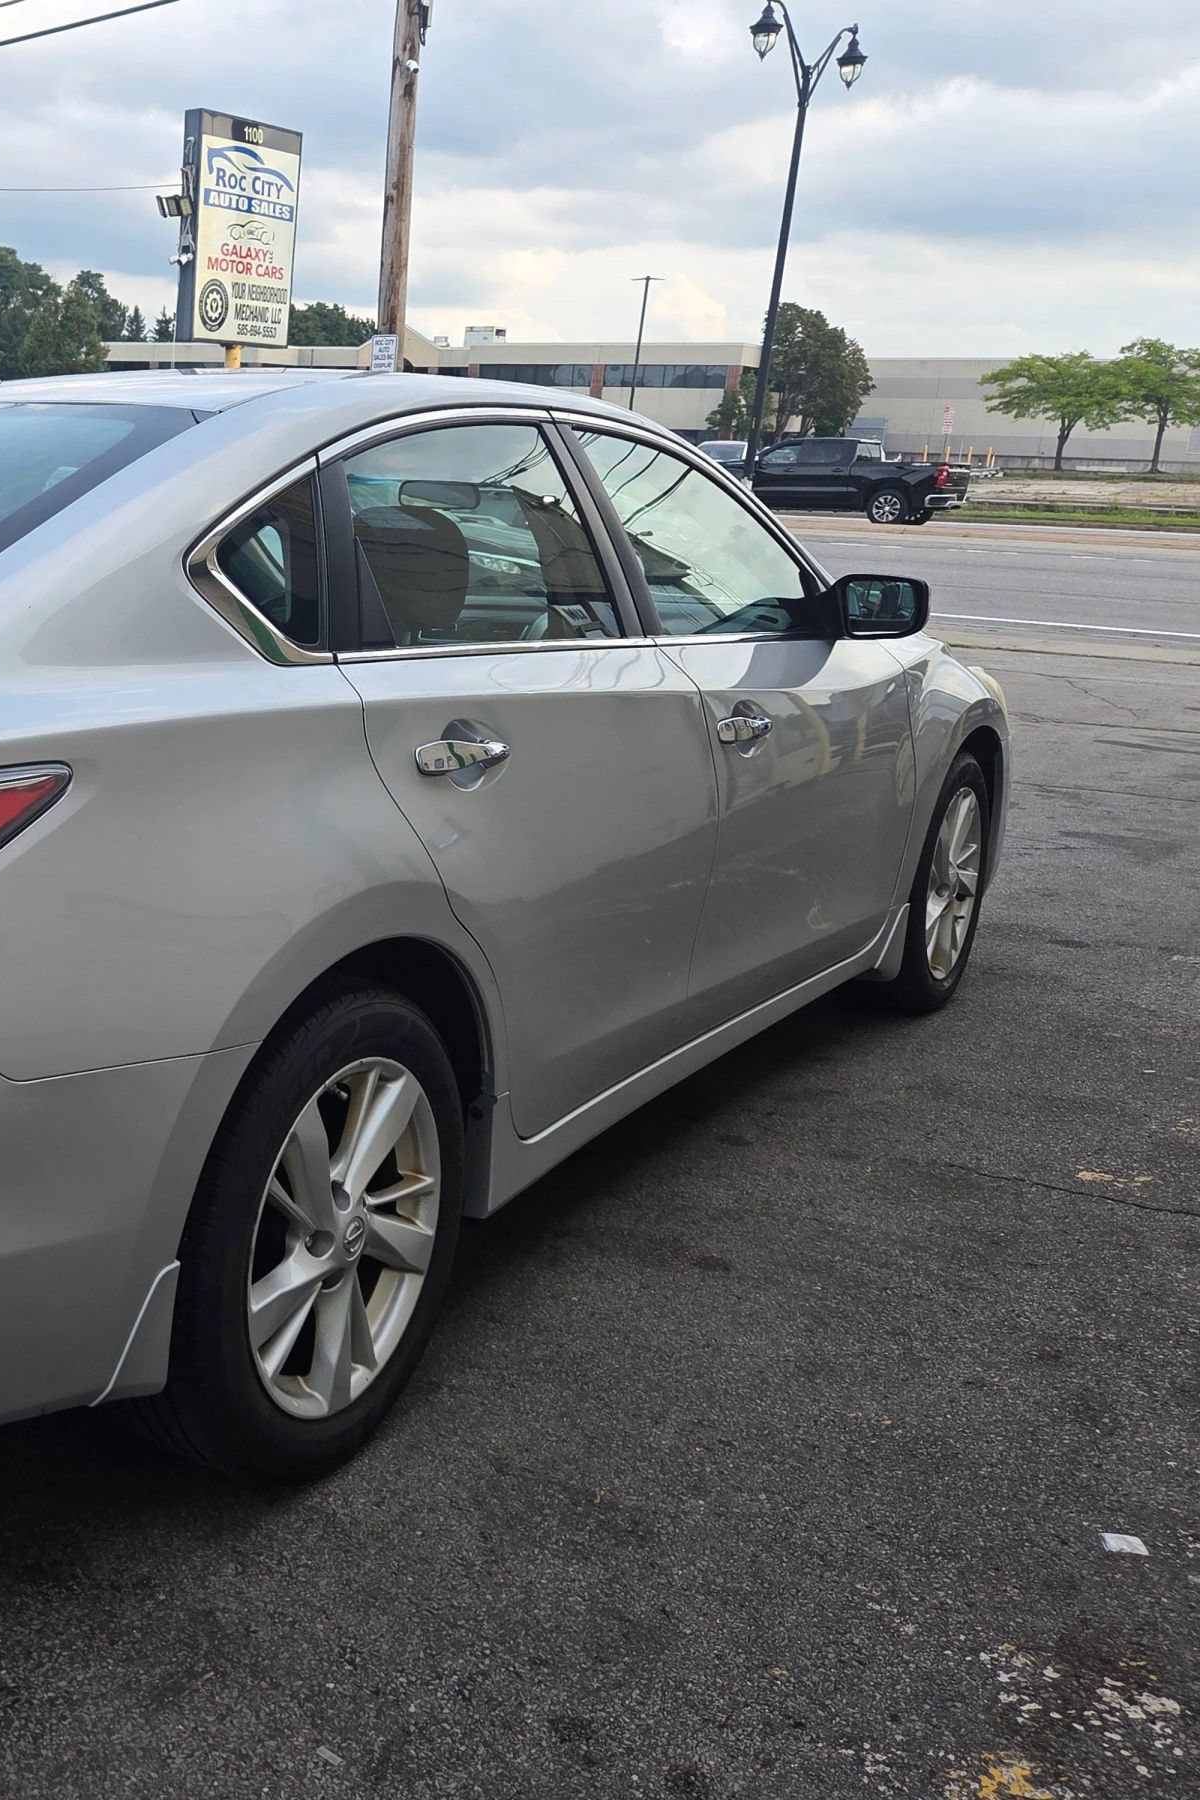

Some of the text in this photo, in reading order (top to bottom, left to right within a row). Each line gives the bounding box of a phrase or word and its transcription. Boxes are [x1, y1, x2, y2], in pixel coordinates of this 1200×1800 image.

[244, 126, 264, 144] 1100
[215, 167, 284, 199] ROC CITY
[208, 191, 291, 220] AUTO SALES
[220, 242, 269, 263] GALAXY
[207, 256, 285, 280] MOTOR CARS
[231, 281, 247, 300] YOUR
[233, 302, 282, 325] MECHANIC LLC
